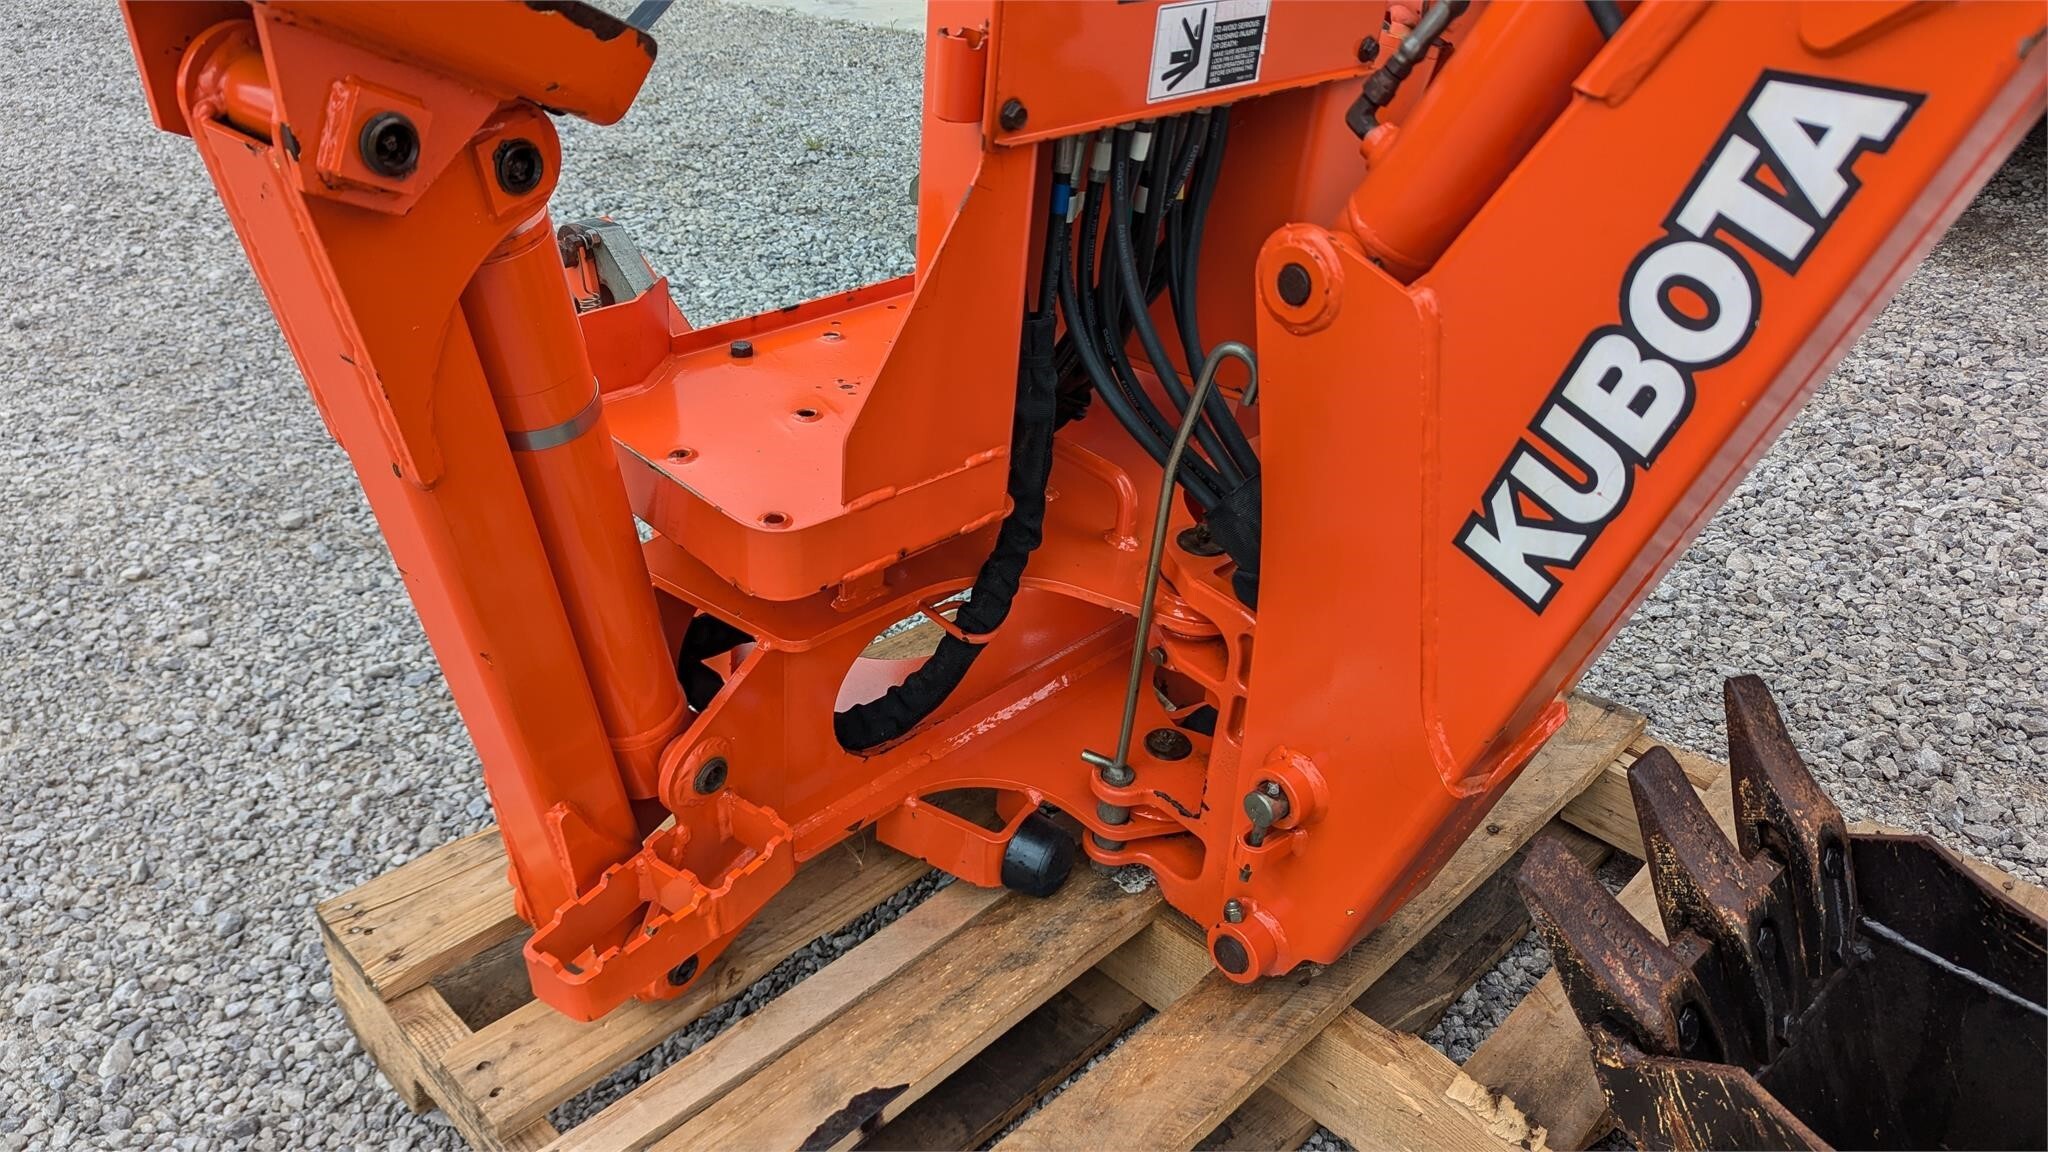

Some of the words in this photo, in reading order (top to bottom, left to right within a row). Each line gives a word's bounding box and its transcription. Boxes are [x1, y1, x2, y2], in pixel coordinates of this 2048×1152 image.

[1238, 20, 1260, 29] SERIOUS
[1213, 32, 1238, 41] CRUSHING
[1239, 29, 1257, 37] INJURY
[1461, 77, 1913, 607] KUBOTA
